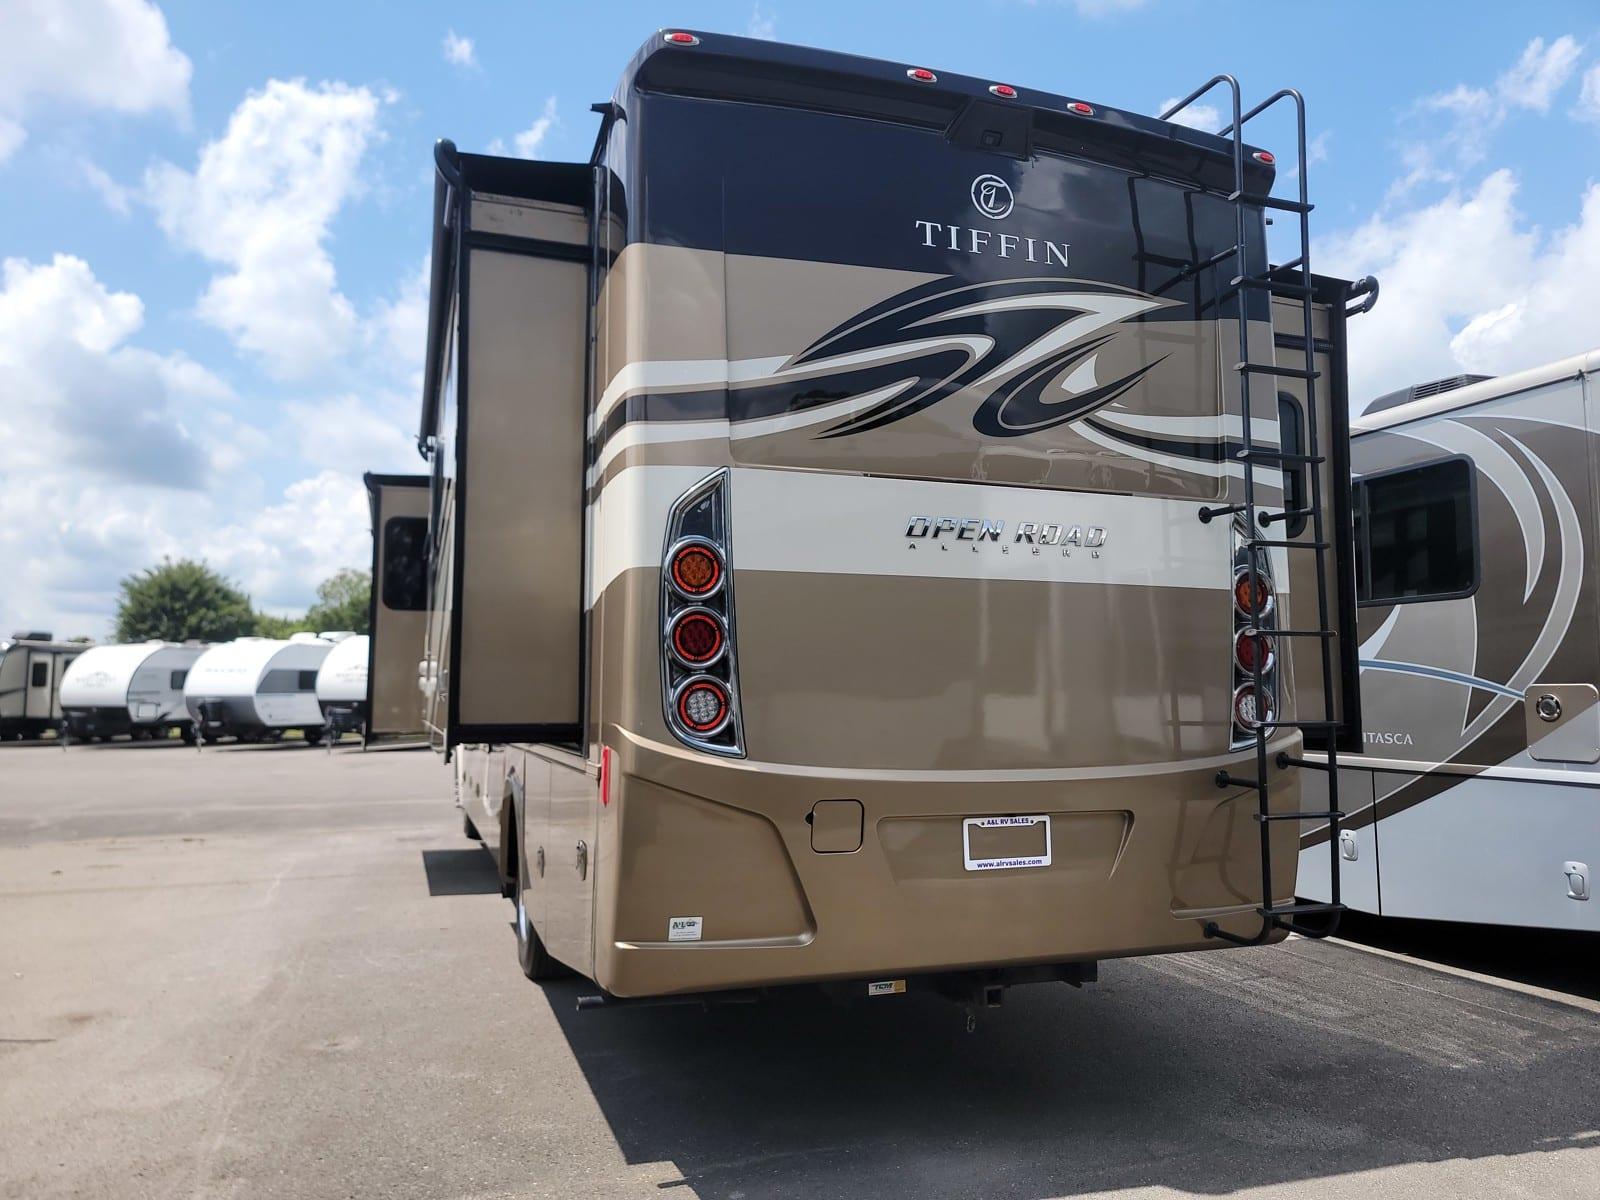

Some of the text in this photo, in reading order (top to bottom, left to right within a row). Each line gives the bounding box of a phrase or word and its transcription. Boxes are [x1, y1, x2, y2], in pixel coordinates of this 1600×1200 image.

[915, 220, 1071, 267] TIFFIN
[905, 515, 1109, 548] OPEN ROAD
[1362, 732, 1413, 745] ITASCA
[976, 859, 1043, 869] www.alrvsales.com
